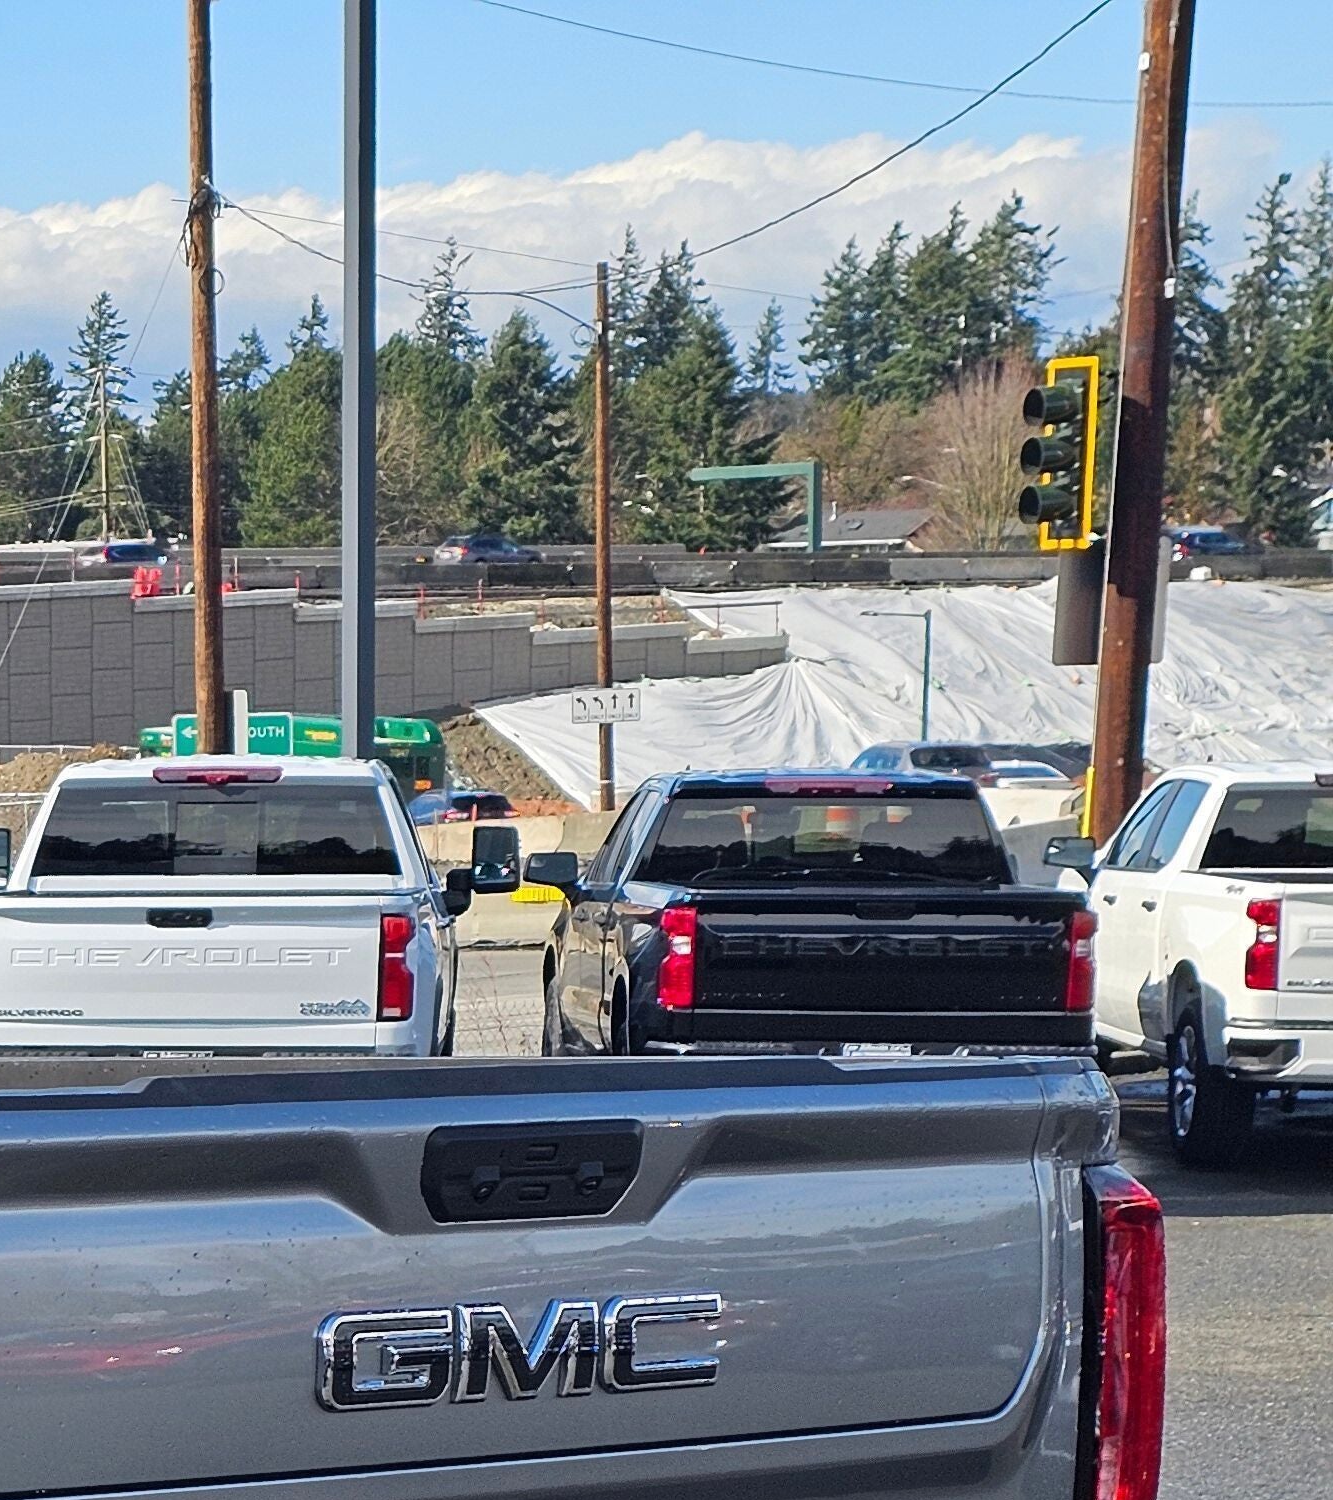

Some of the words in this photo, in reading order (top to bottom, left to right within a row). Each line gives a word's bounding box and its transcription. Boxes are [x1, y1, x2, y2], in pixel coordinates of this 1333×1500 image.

[248, 726, 285, 738] OUTH
[10, 947, 351, 967] CHEVROLET
[721, 937, 1047, 957] CHEVROLET
[314, 1292, 724, 1413] GMC
